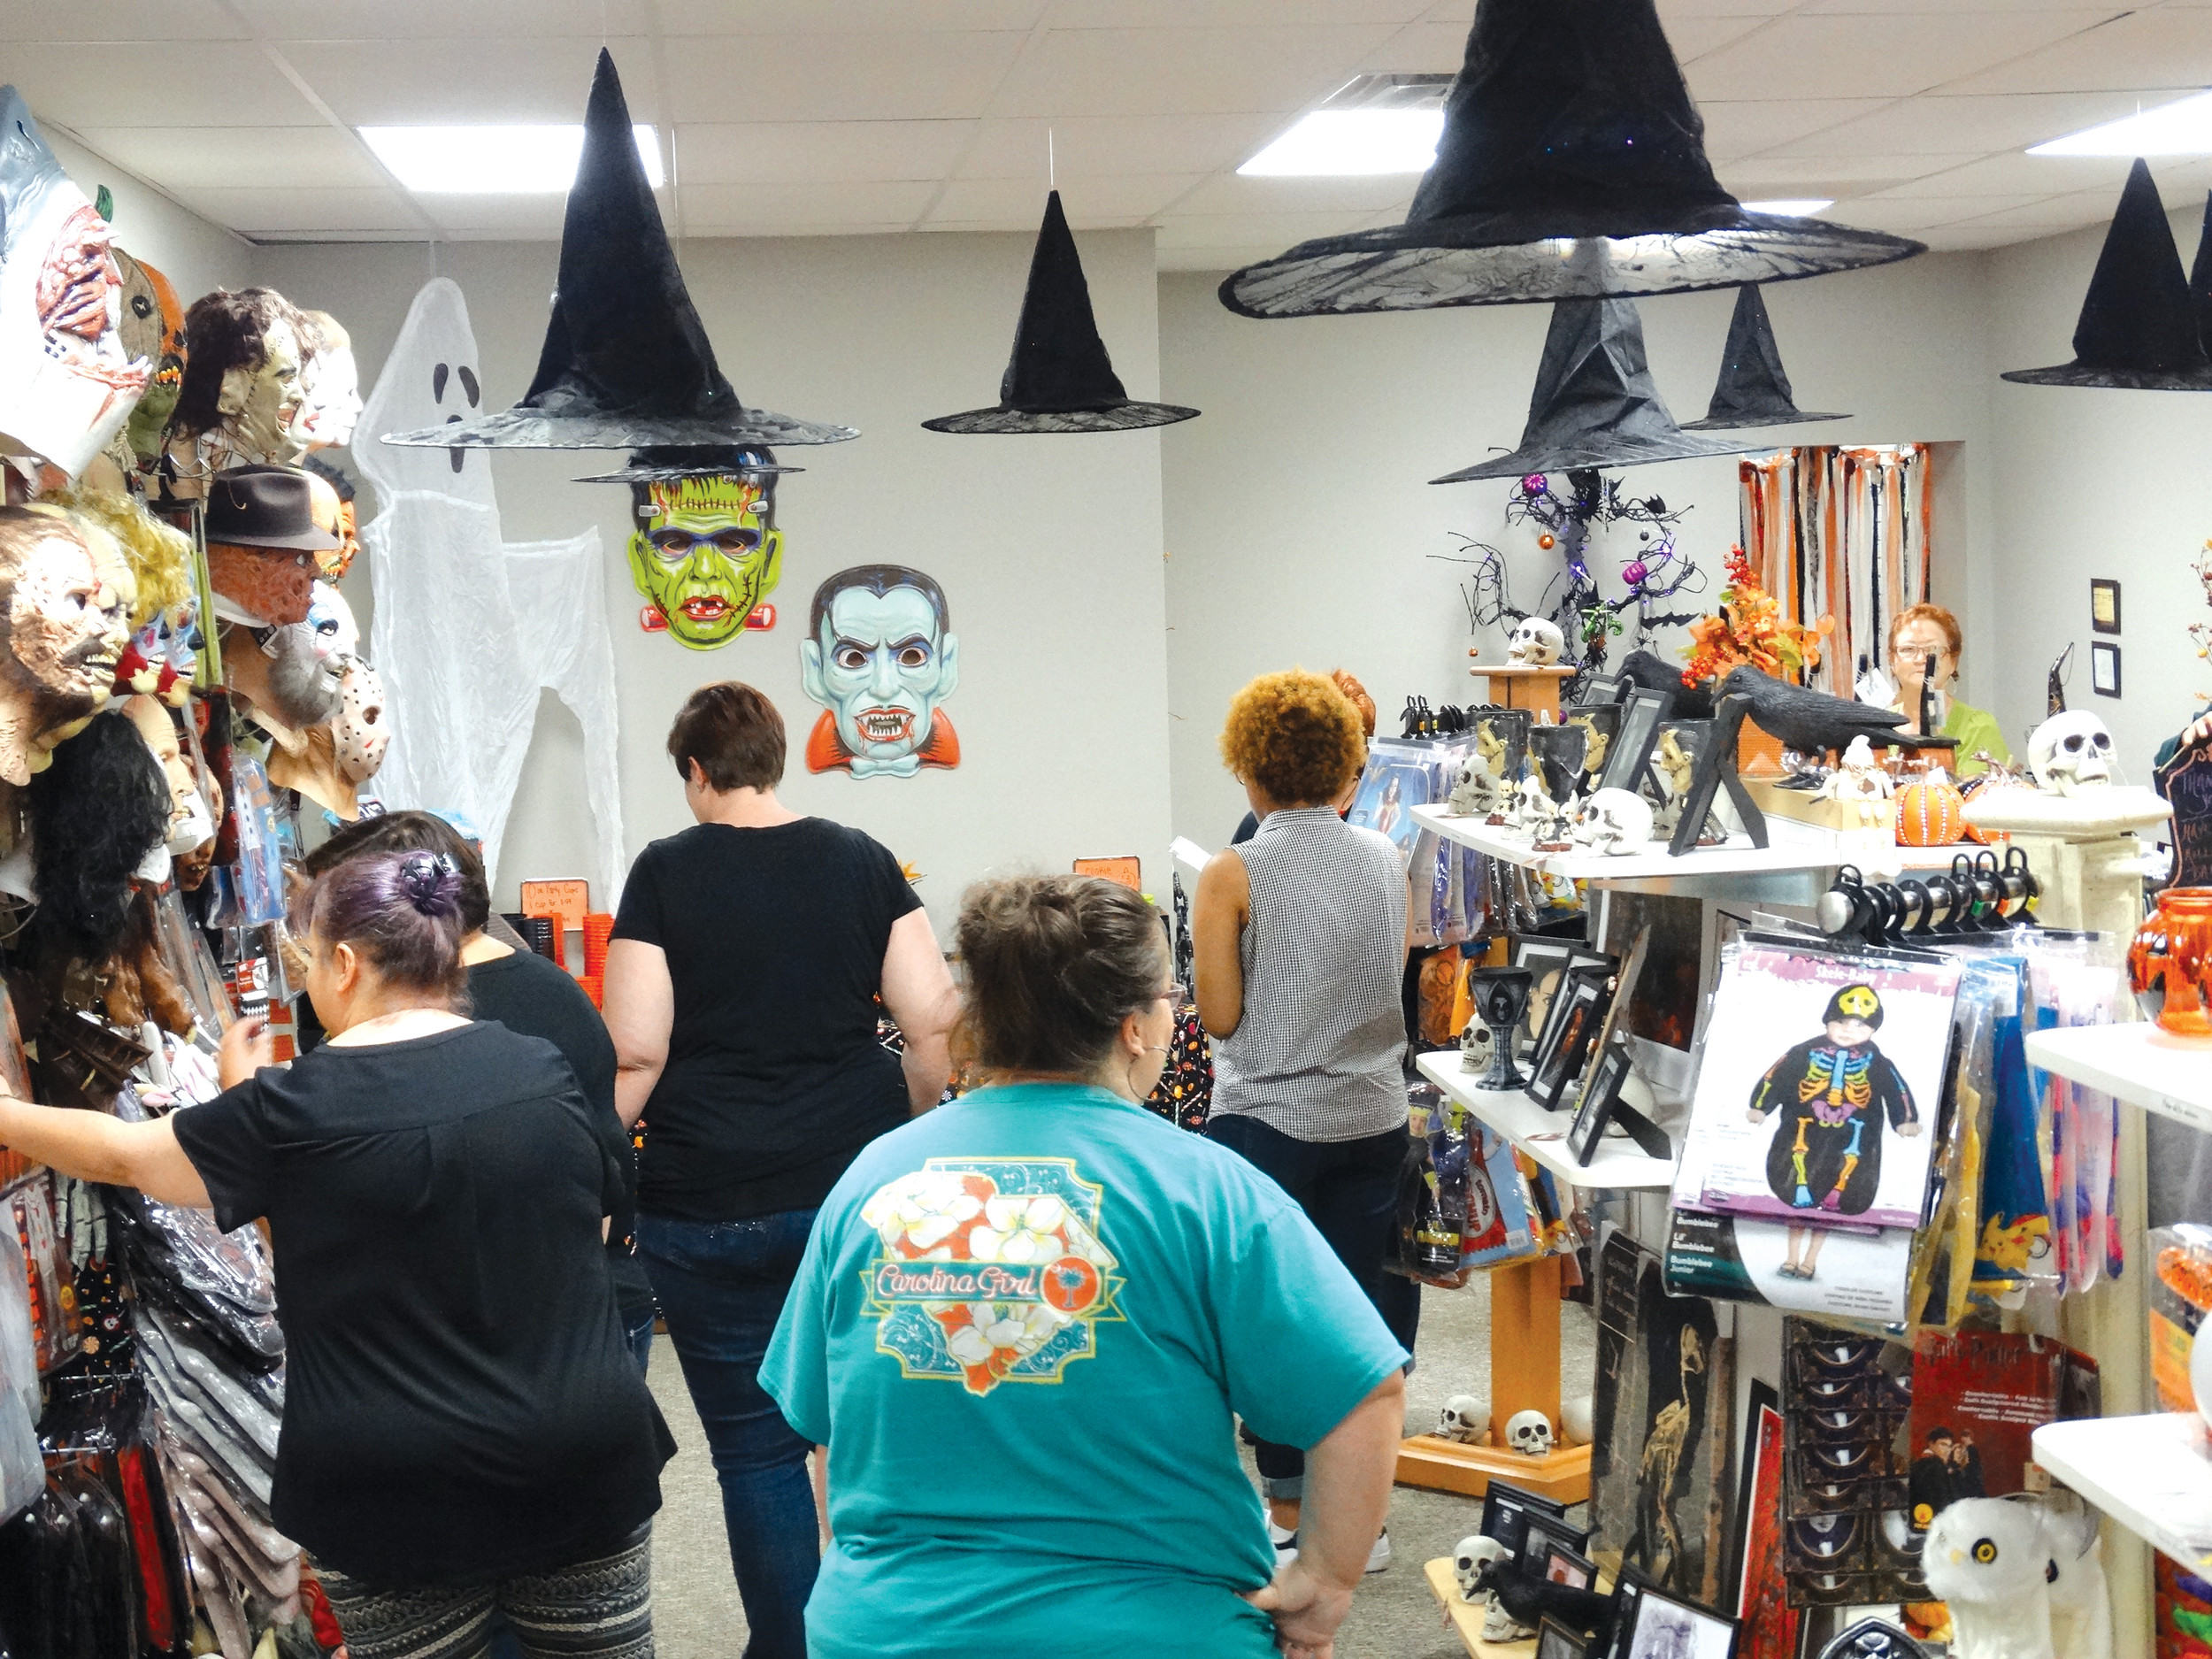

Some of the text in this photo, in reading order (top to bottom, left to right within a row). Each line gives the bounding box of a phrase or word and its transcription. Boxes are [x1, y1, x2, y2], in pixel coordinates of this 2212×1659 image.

[1475, 1179, 1490, 1216] tomato
[877, 1264, 1038, 1299] Carolina Girl
